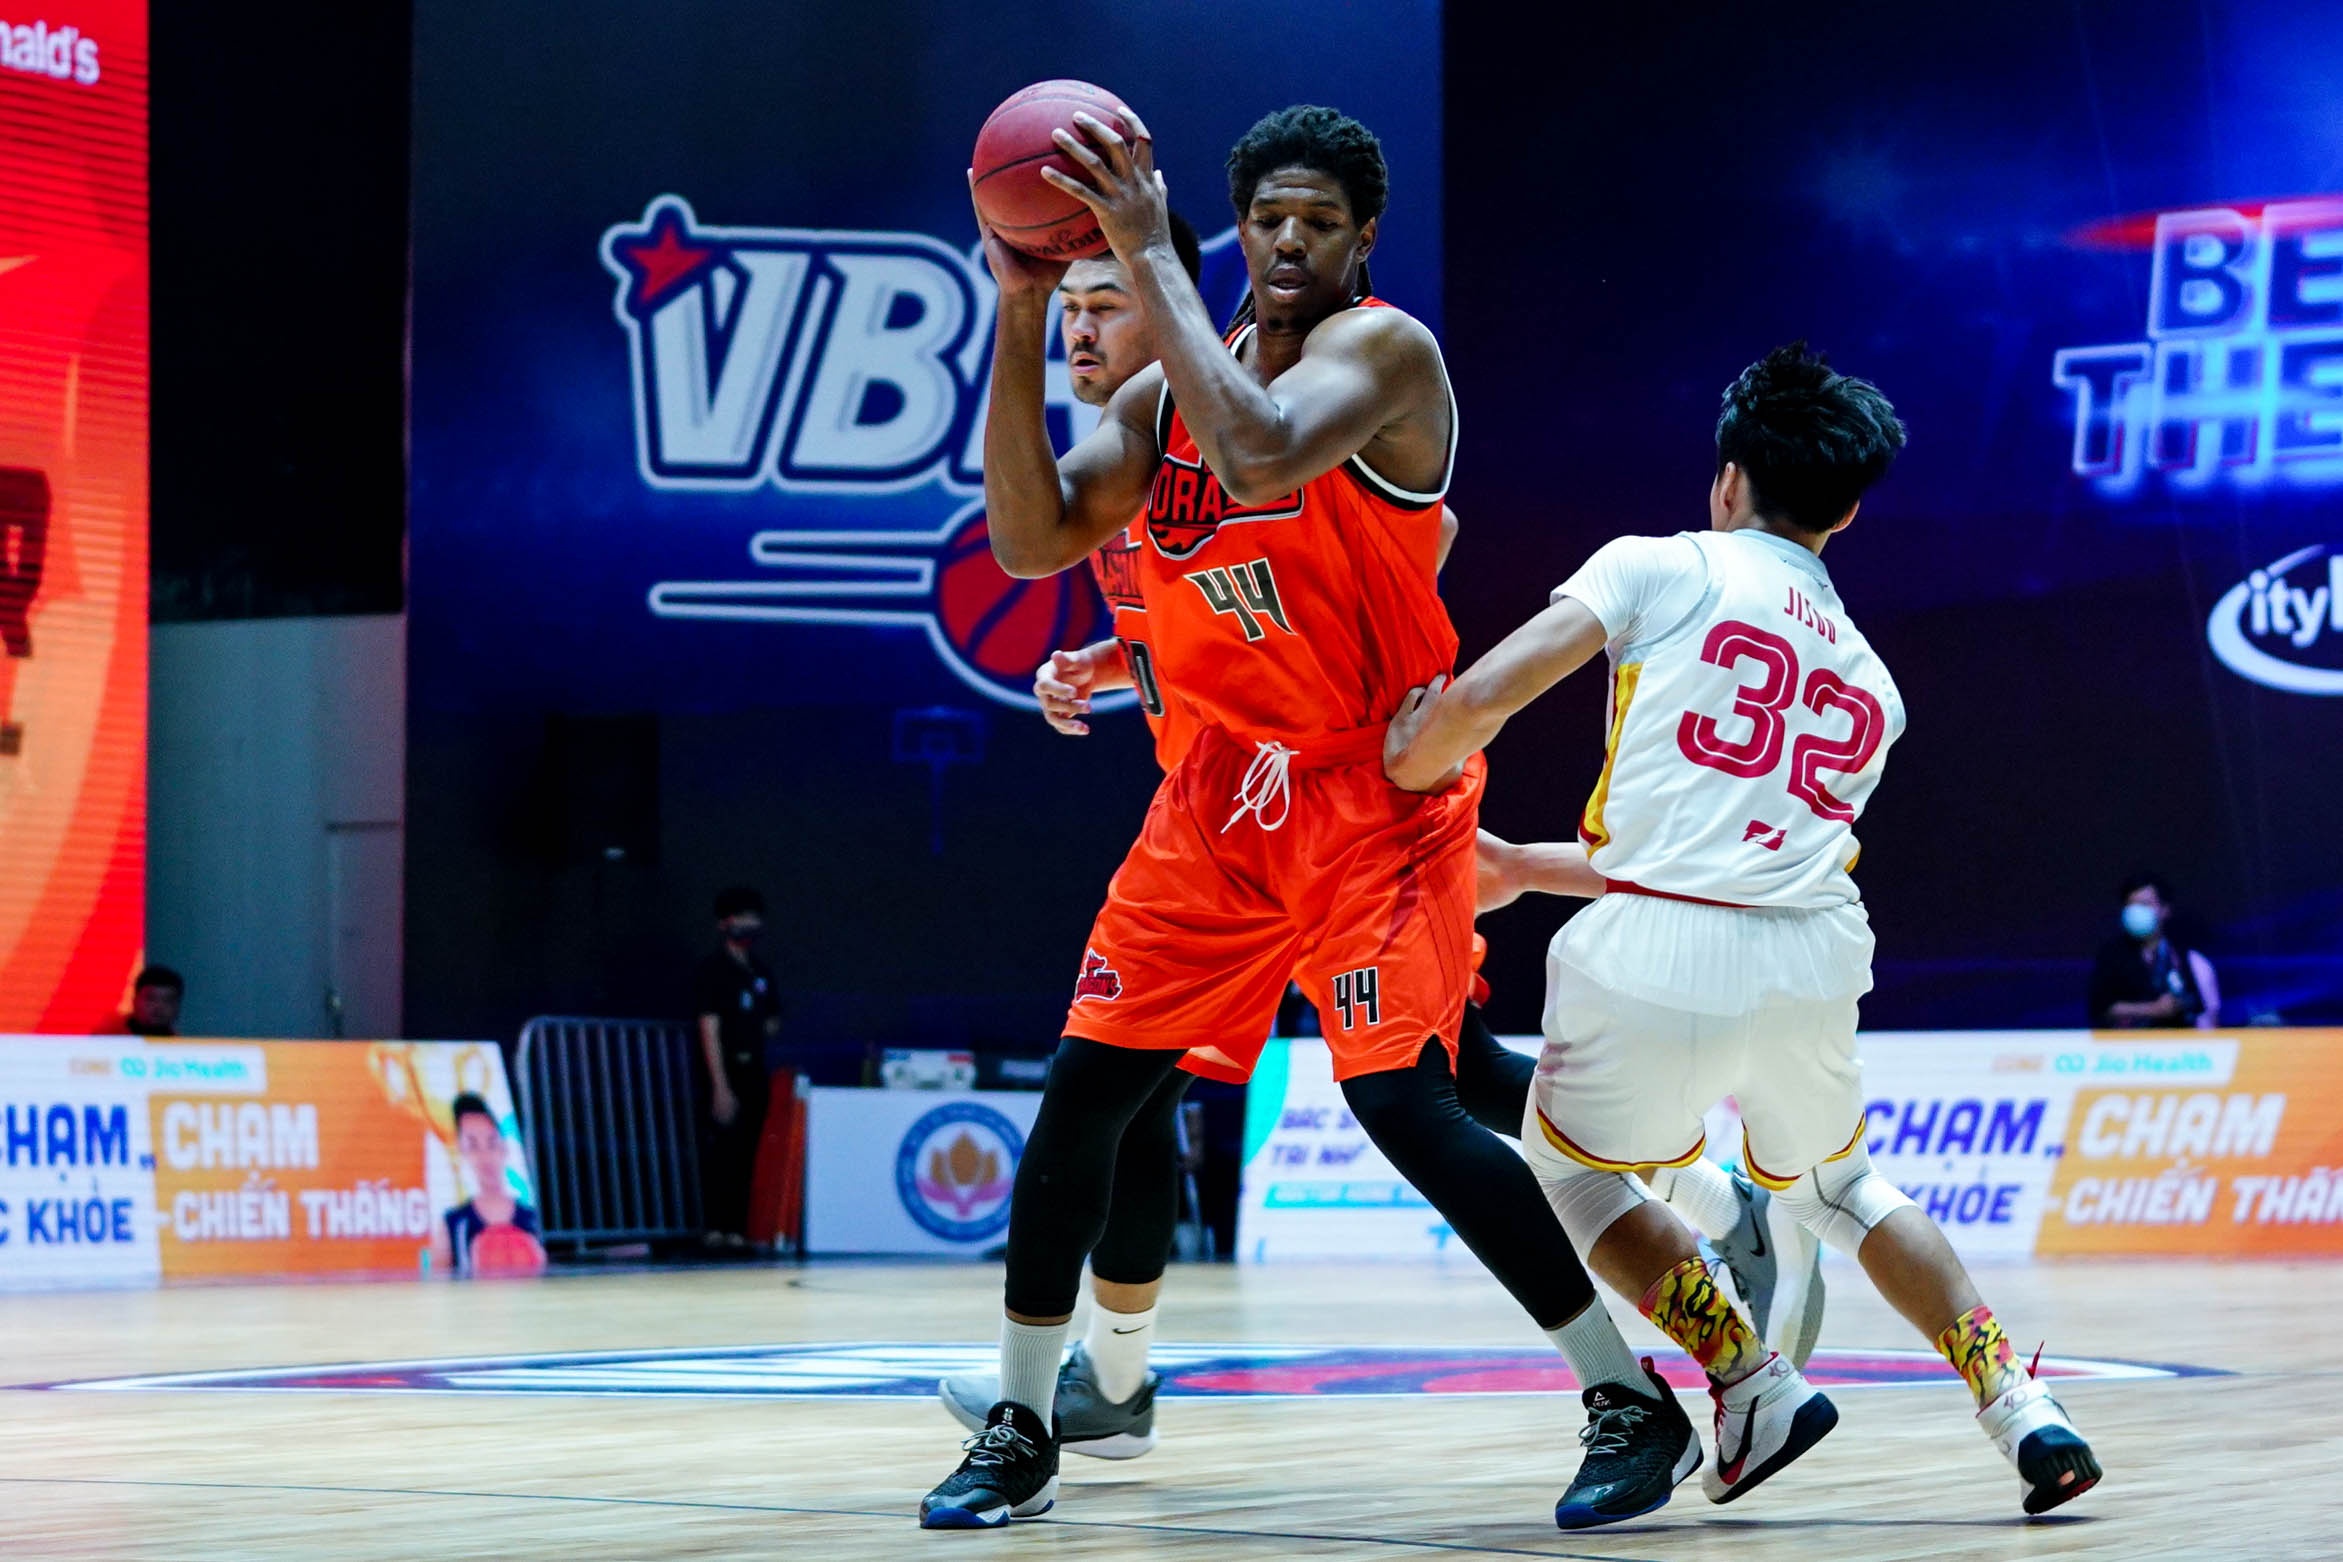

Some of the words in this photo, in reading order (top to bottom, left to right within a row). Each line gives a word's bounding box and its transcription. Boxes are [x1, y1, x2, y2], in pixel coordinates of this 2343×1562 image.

[1184, 557, 1298, 642] 44
[1677, 620, 1885, 824] 32
[1331, 966, 1380, 1030] 44
